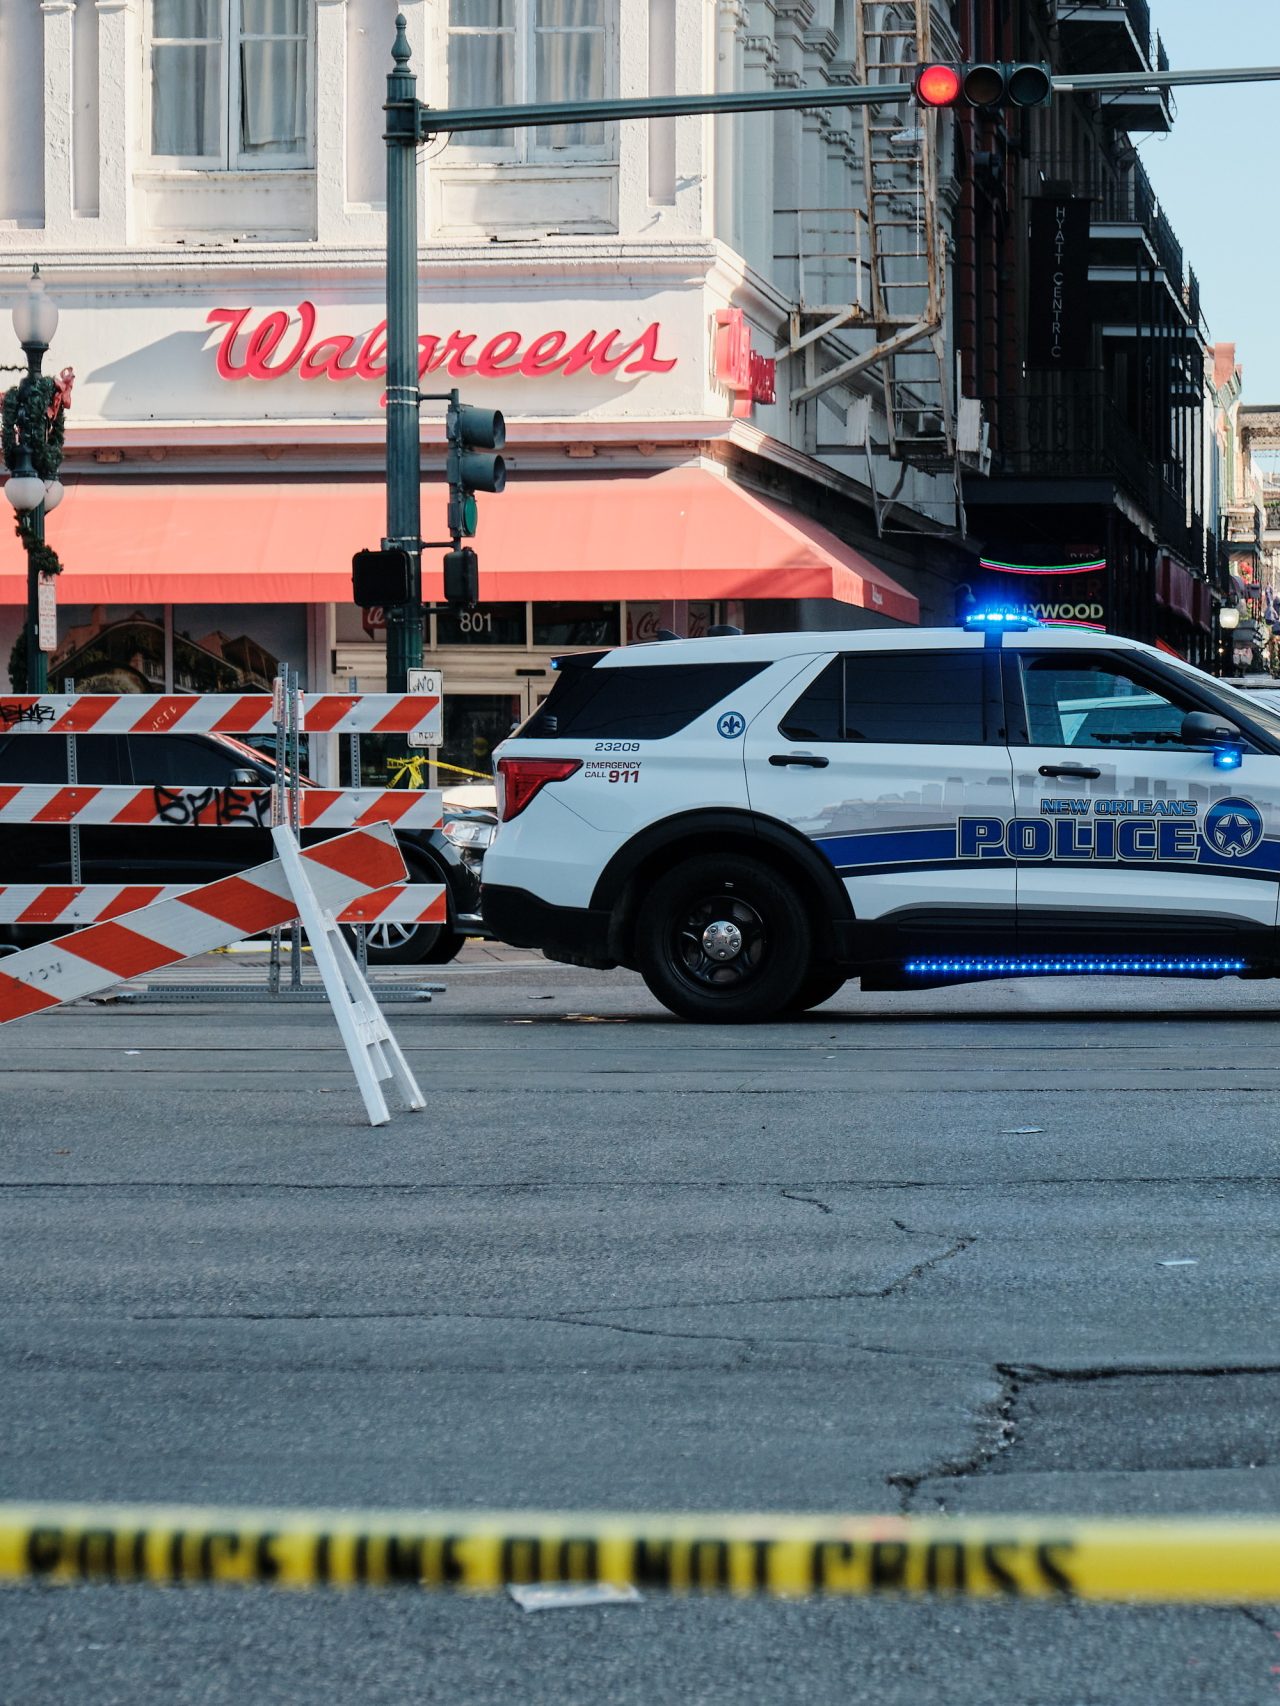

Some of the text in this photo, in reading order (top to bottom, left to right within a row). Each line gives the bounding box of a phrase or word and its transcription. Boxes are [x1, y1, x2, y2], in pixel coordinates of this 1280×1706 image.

[1051, 206, 1066, 358] HYATT CENTRIC
[460, 612, 492, 632] 801
[594, 742, 641, 752] 23209
[585, 761, 642, 769] EMERGENCY
[608, 770, 640, 783] 911
[1040, 798, 1199, 816] NEW ORLEANS
[956, 816, 1201, 862] POLICE
[26, 1527, 1074, 1595] POLICE LINE DO NOT CROSS
